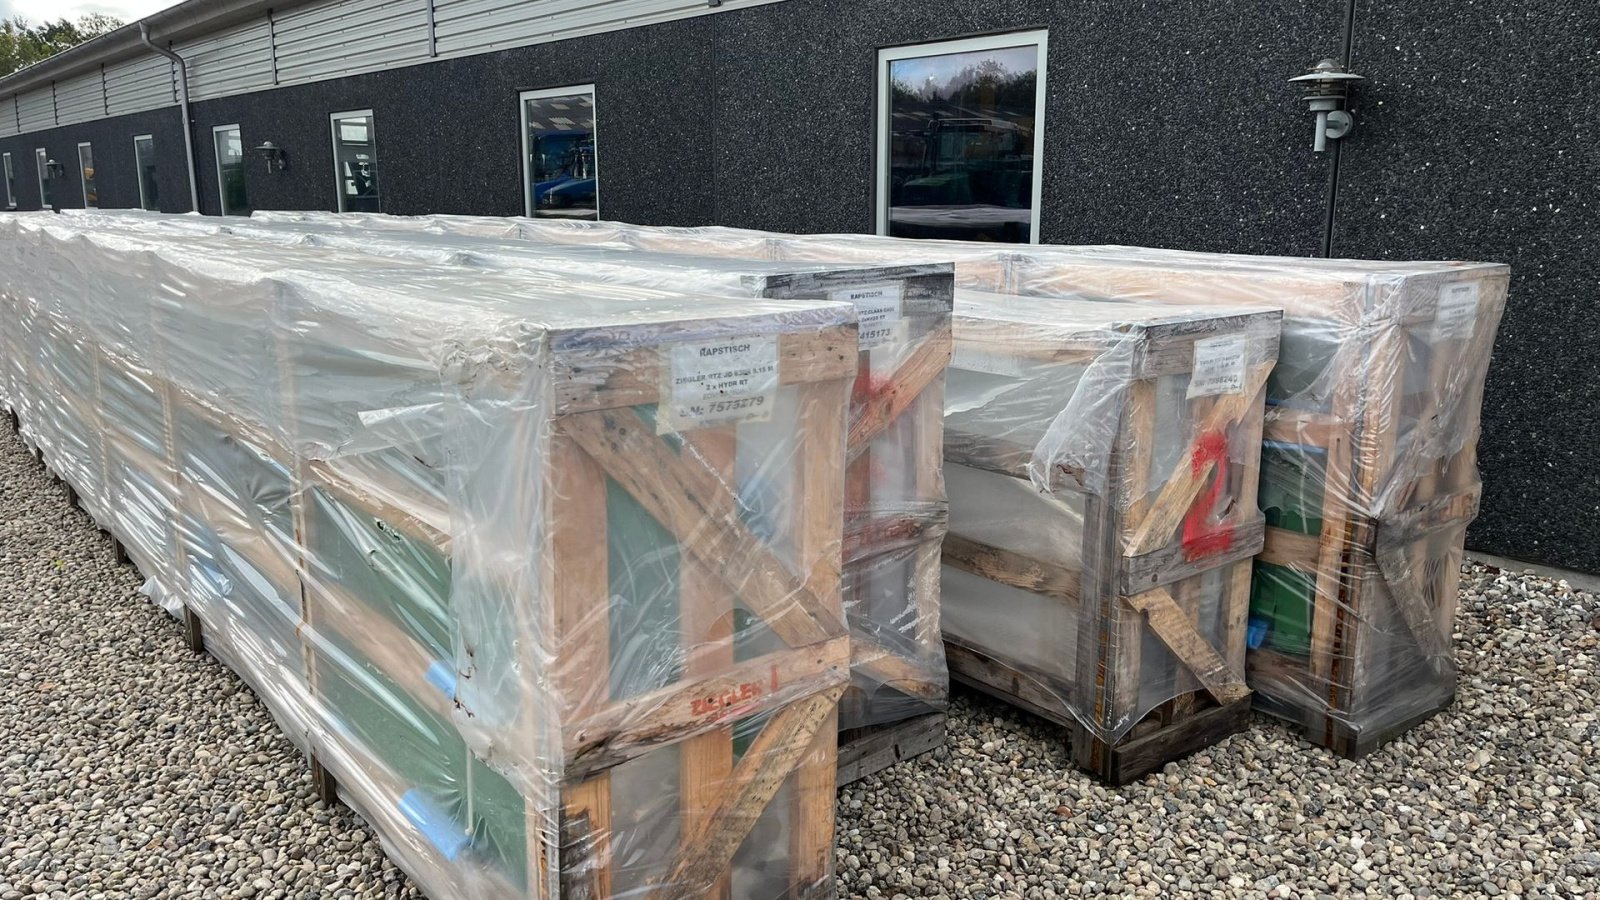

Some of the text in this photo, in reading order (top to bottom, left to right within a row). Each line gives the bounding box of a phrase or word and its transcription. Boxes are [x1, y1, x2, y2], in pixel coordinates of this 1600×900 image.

[699, 344, 751, 357] RAPSTISCH
[675, 374, 706, 385] ZIEGLER
[718, 380, 738, 390] HYDR
[1181, 433, 1236, 563] 2
[690, 681, 764, 717] ZIEGLER
